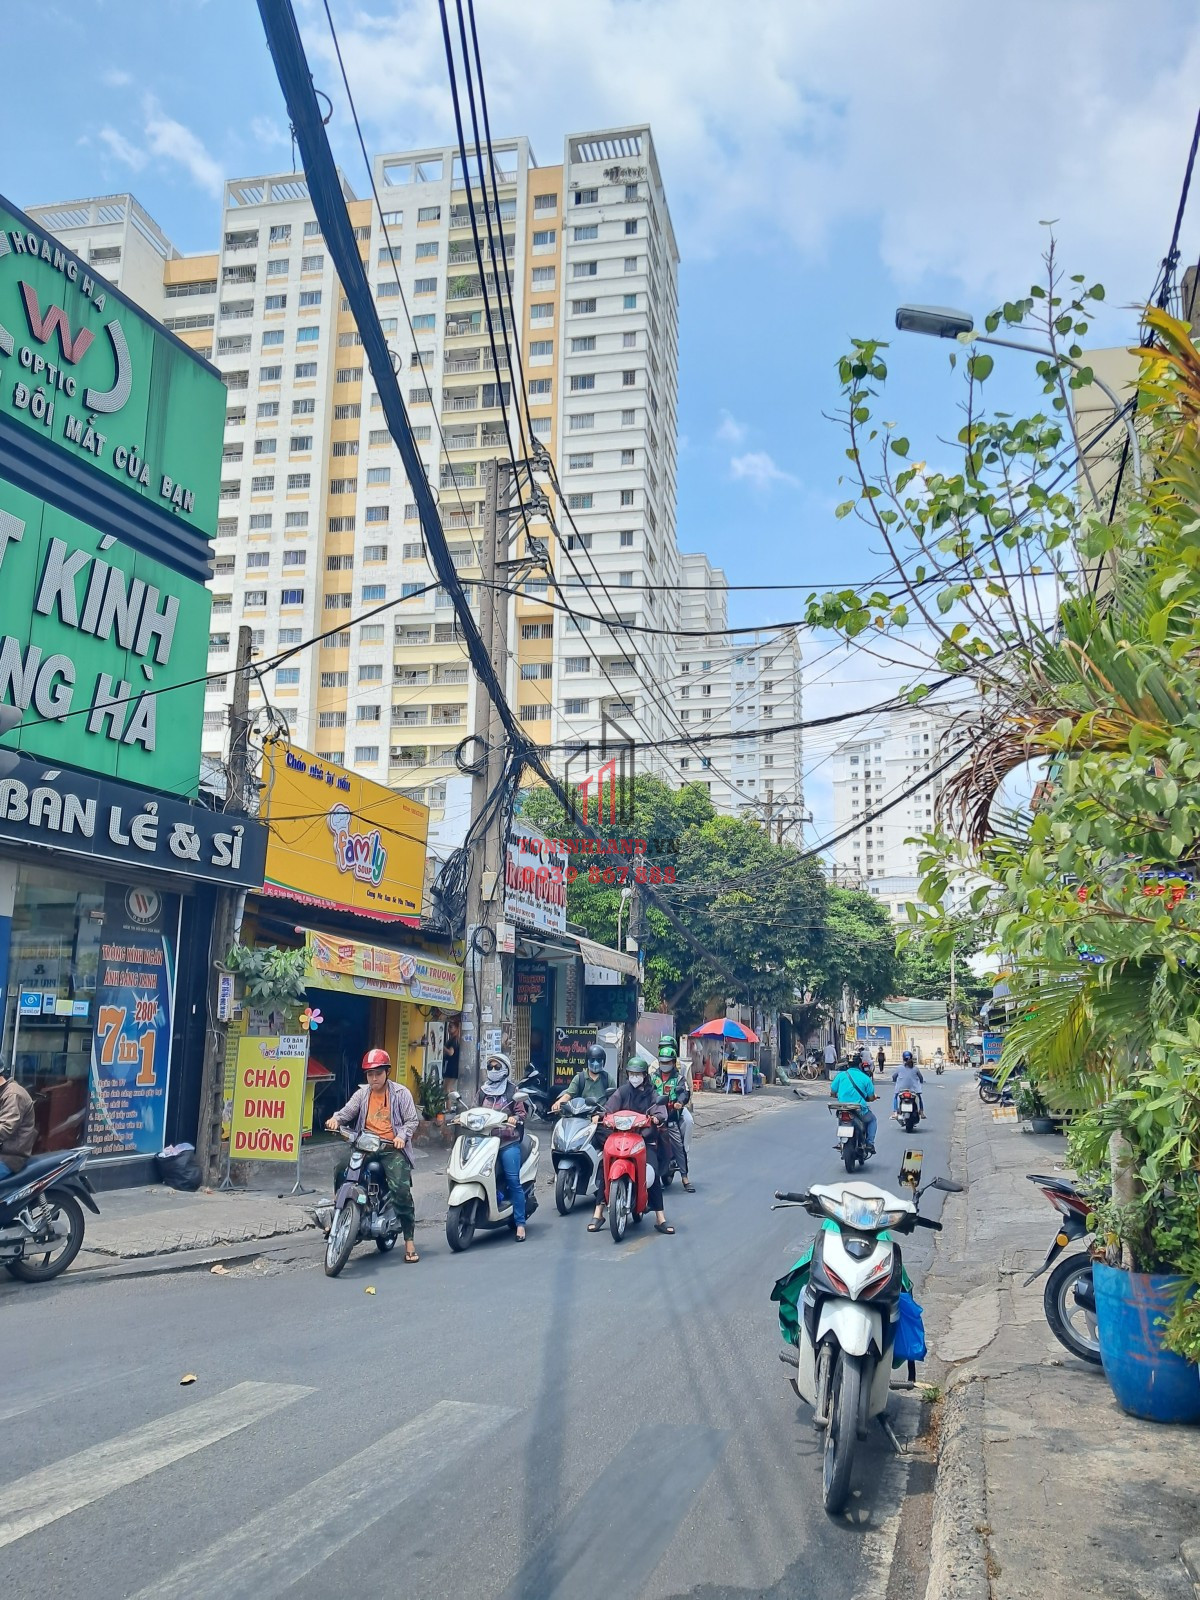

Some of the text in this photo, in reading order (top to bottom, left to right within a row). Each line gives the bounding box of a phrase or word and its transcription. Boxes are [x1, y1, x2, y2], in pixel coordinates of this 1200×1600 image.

[11, 231, 107, 312] HOANG HA
[19, 346, 76, 397] OPTIC
[14, 381, 196, 514] ĐÔI MẮT CỦA BẠN
[34, 534, 181, 666] KÍNH
[87, 663, 156, 751] HÀ
[286, 752, 306, 773] Cháo
[0, 771, 245, 870] BÁN LẺ & SỈ
[339, 830, 385, 881] family
[358, 865, 372, 875] SOUP
[243, 1065, 291, 1089] CHÁO
[556, 1067, 573, 1075] NAM
[244, 1099, 286, 1119] DINH
[235, 1127, 294, 1153] DƯỠNG
